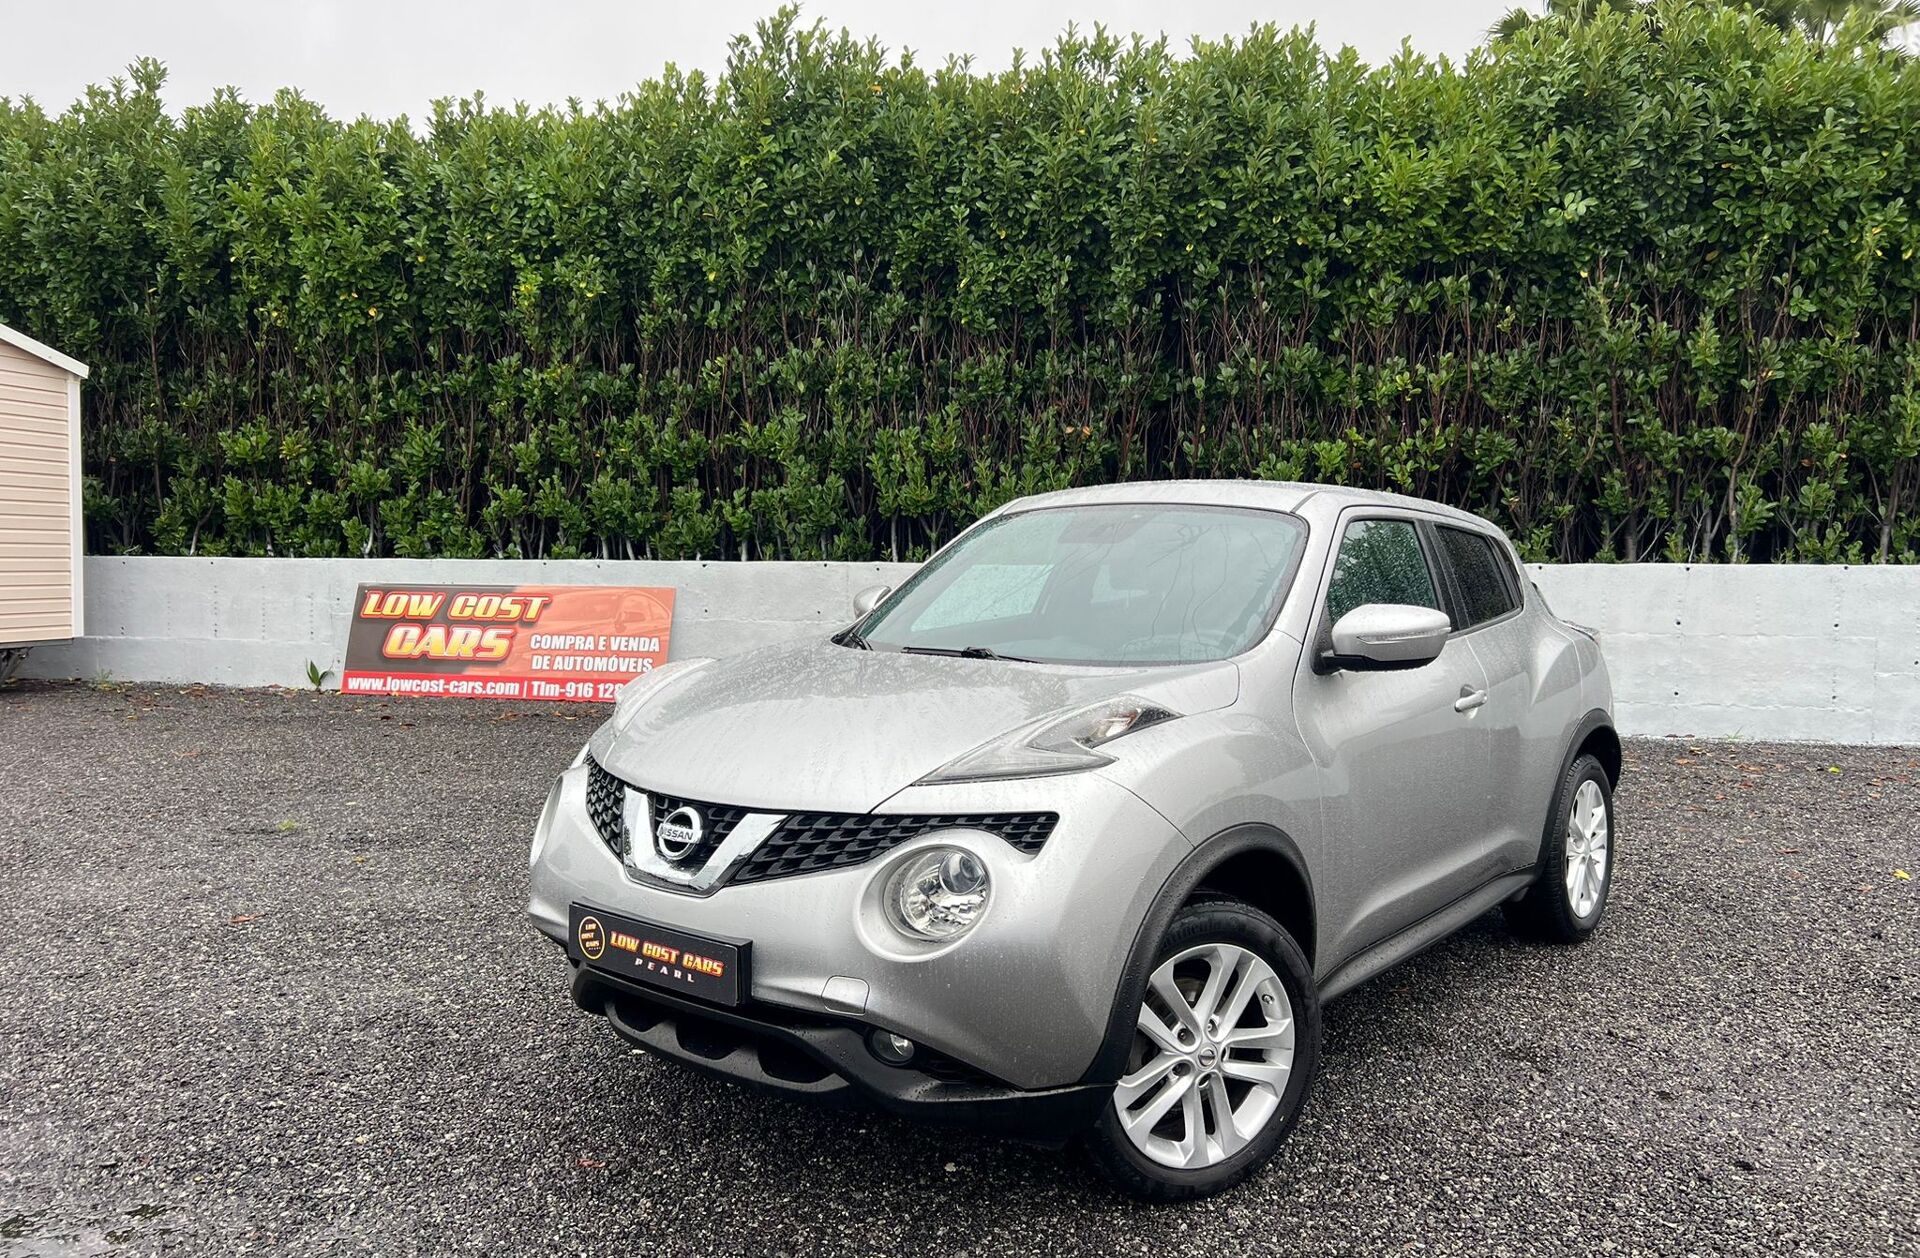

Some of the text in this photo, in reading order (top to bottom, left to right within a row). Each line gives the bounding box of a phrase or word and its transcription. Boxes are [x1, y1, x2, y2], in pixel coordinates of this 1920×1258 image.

[363, 593, 549, 618] LOW COST
[386, 625, 513, 657] CARS
[531, 634, 660, 652] COMPRA E VENDA
[532, 655, 653, 672] DE AUTOMÓVEIS
[348, 677, 519, 695] www.lowcost-cars.com
[610, 931, 725, 977] LOW COST CARS
[635, 957, 695, 983] PEARL
